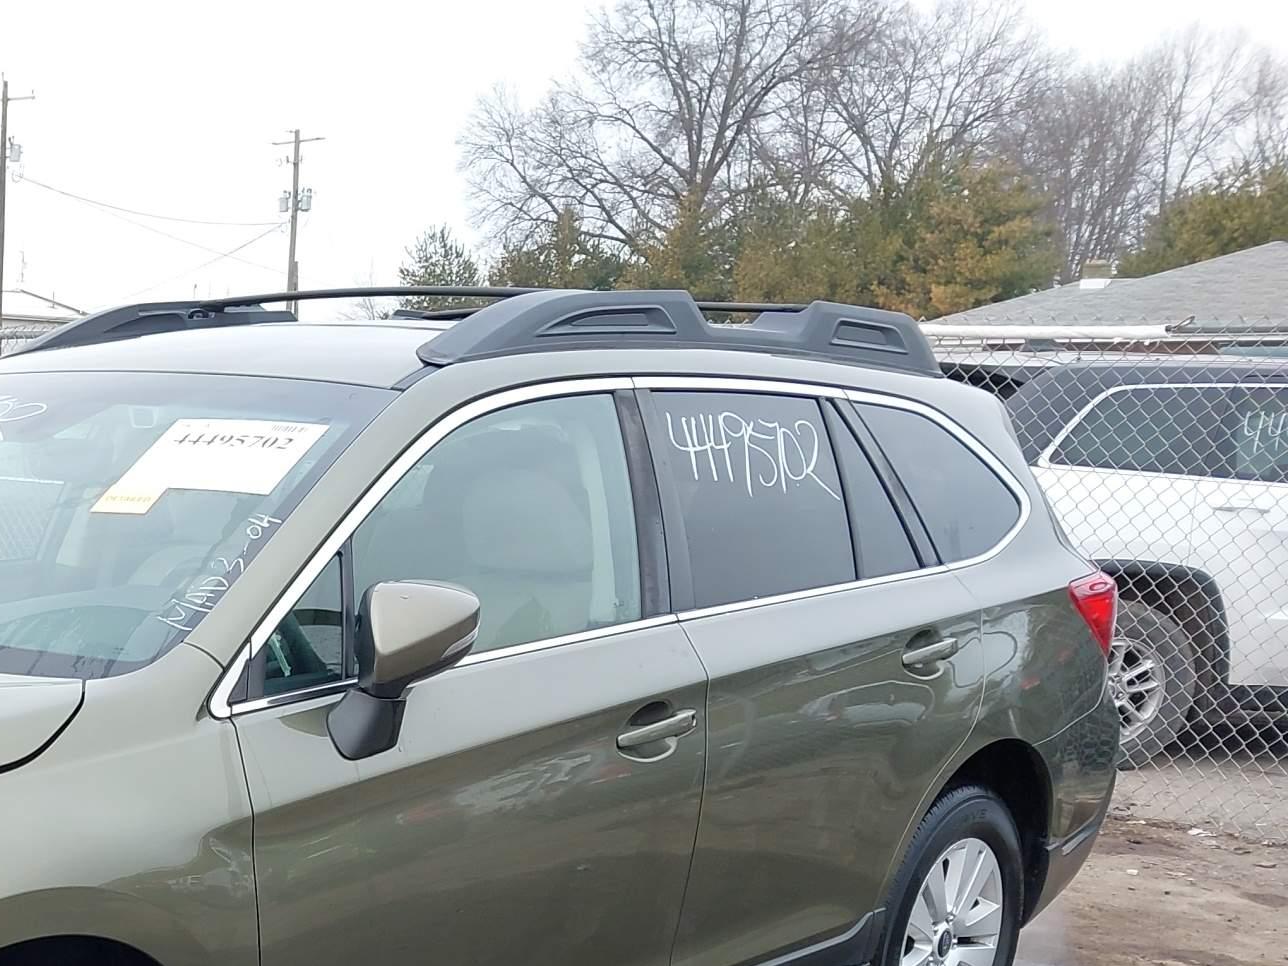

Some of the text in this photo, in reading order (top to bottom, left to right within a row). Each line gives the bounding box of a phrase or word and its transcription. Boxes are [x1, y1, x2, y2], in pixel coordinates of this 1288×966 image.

[174, 432, 294, 450] 44495702
[1244, 411, 1288, 454] 44
[666, 411, 841, 500] 44495702
